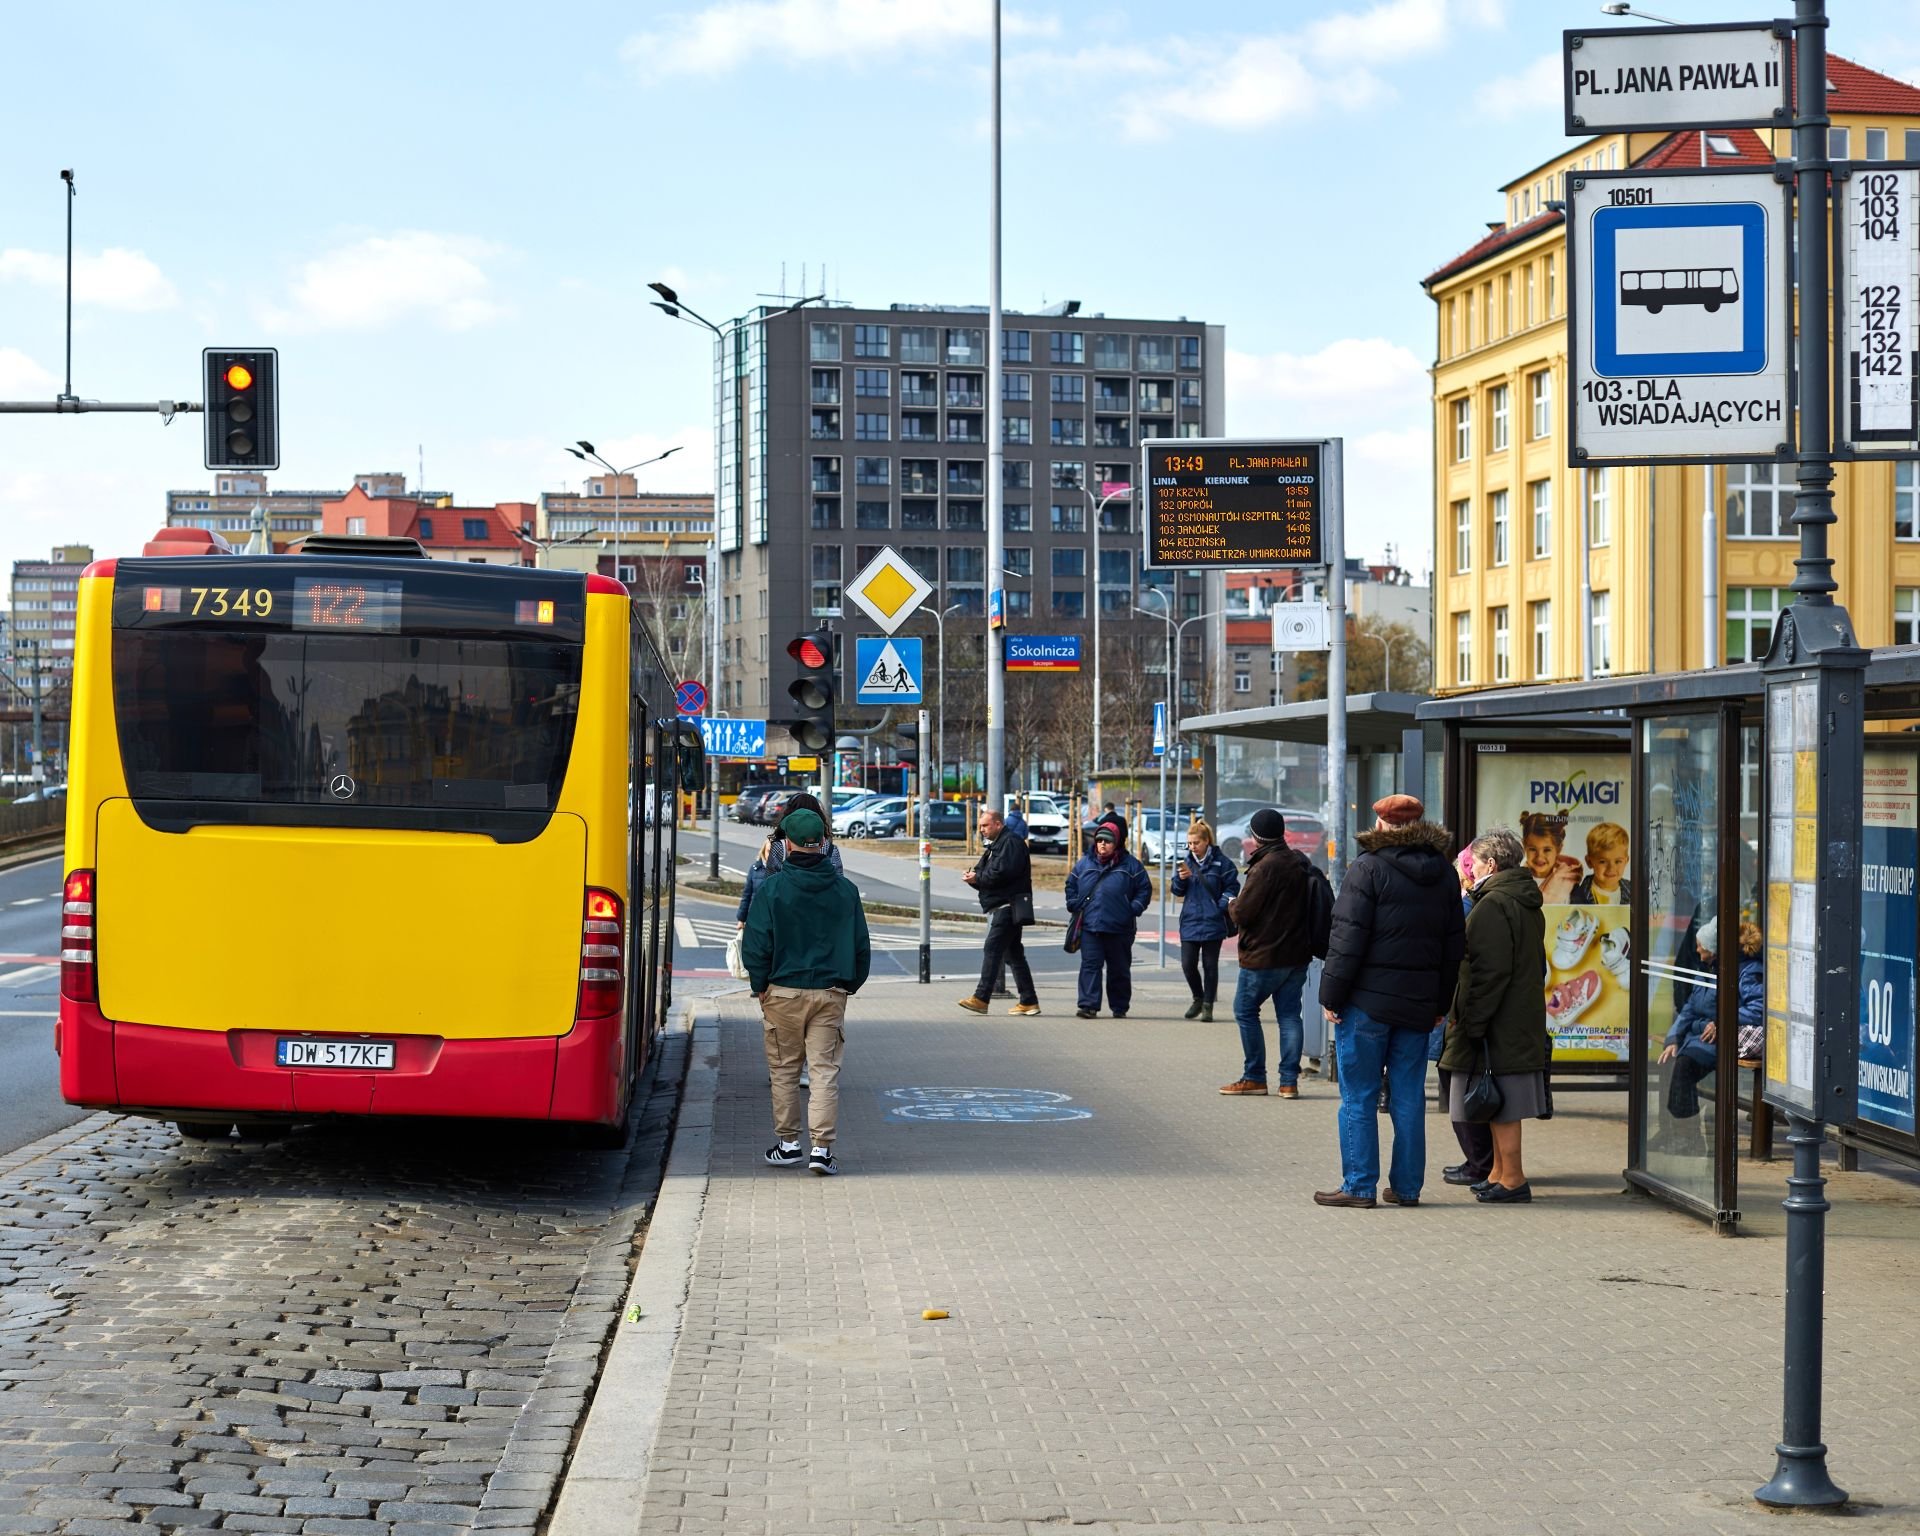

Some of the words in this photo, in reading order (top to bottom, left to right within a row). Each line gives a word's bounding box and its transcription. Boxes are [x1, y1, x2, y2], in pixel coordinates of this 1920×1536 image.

[1575, 69, 1609, 95] PL.
[1614, 66, 1673, 94] JANA
[1679, 62, 1758, 91] PAWŁA
[1765, 61, 1778, 87] II
[1859, 174, 1899, 196] 102
[1607, 188, 1653, 206] 10501
[1859, 195, 1899, 218] 103
[1859, 217, 1899, 240] 104
[1860, 285, 1900, 308] 122
[1860, 308, 1900, 331] 127
[1861, 331, 1901, 354] 132
[1861, 355, 1902, 376] 142
[1582, 380, 1622, 402] 103
[1637, 379, 1681, 401] DLA
[1598, 400, 1781, 428] WSIADAJĄCYCH
[1164, 456, 1205, 472] 13:49
[1229, 457, 1245, 469] PL.
[1247, 457, 1269, 468] JANA
[1271, 457, 1301, 468] PAWŁA
[1153, 477, 1177, 486] LINIA
[1205, 476, 1250, 485] KIERUNEK
[1278, 475, 1314, 485] ODJAZD
[1158, 489, 1174, 497] 107
[1176, 488, 1209, 497] KRZYKI
[1285, 486, 1309, 496] 13:59
[1159, 501, 1174, 510] 132
[1176, 499, 1213, 510] OPORÓW
[1286, 499, 1295, 508] 11
[1296, 498, 1312, 508] min
[1160, 513, 1175, 523] 102
[1178, 511, 1240, 522] OSMONAUTÓW
[1286, 511, 1310, 521] 14:02
[1160, 526, 1175, 535] 103
[1177, 524, 1220, 535] JANÓWEK
[1286, 523, 1311, 533] 14:06
[1158, 538, 1175, 547] 104
[1177, 536, 1226, 548] RĘDZIŃSKA
[1286, 536, 1311, 546] 14:07
[1158, 549, 1194, 560] JAKOŚĆ
[1195, 549, 1248, 559] POWIETRZA:
[1249, 549, 1311, 559] UMIARKOWANA
[190, 588, 274, 618] 7349
[307, 585, 366, 625] 122
[1011, 644, 1075, 657] Sokolnicza
[1530, 781, 1619, 804] PRIMIGI
[1862, 863, 1878, 892] REET
[1879, 865, 1915, 896] FOODEM?
[1868, 979, 1893, 1046] 0.0
[1558, 1026, 1574, 1034] ABY
[1576, 1025, 1611, 1035] WYBRAĆ
[291, 1043, 318, 1063] DW
[325, 1044, 388, 1065] 517KF
